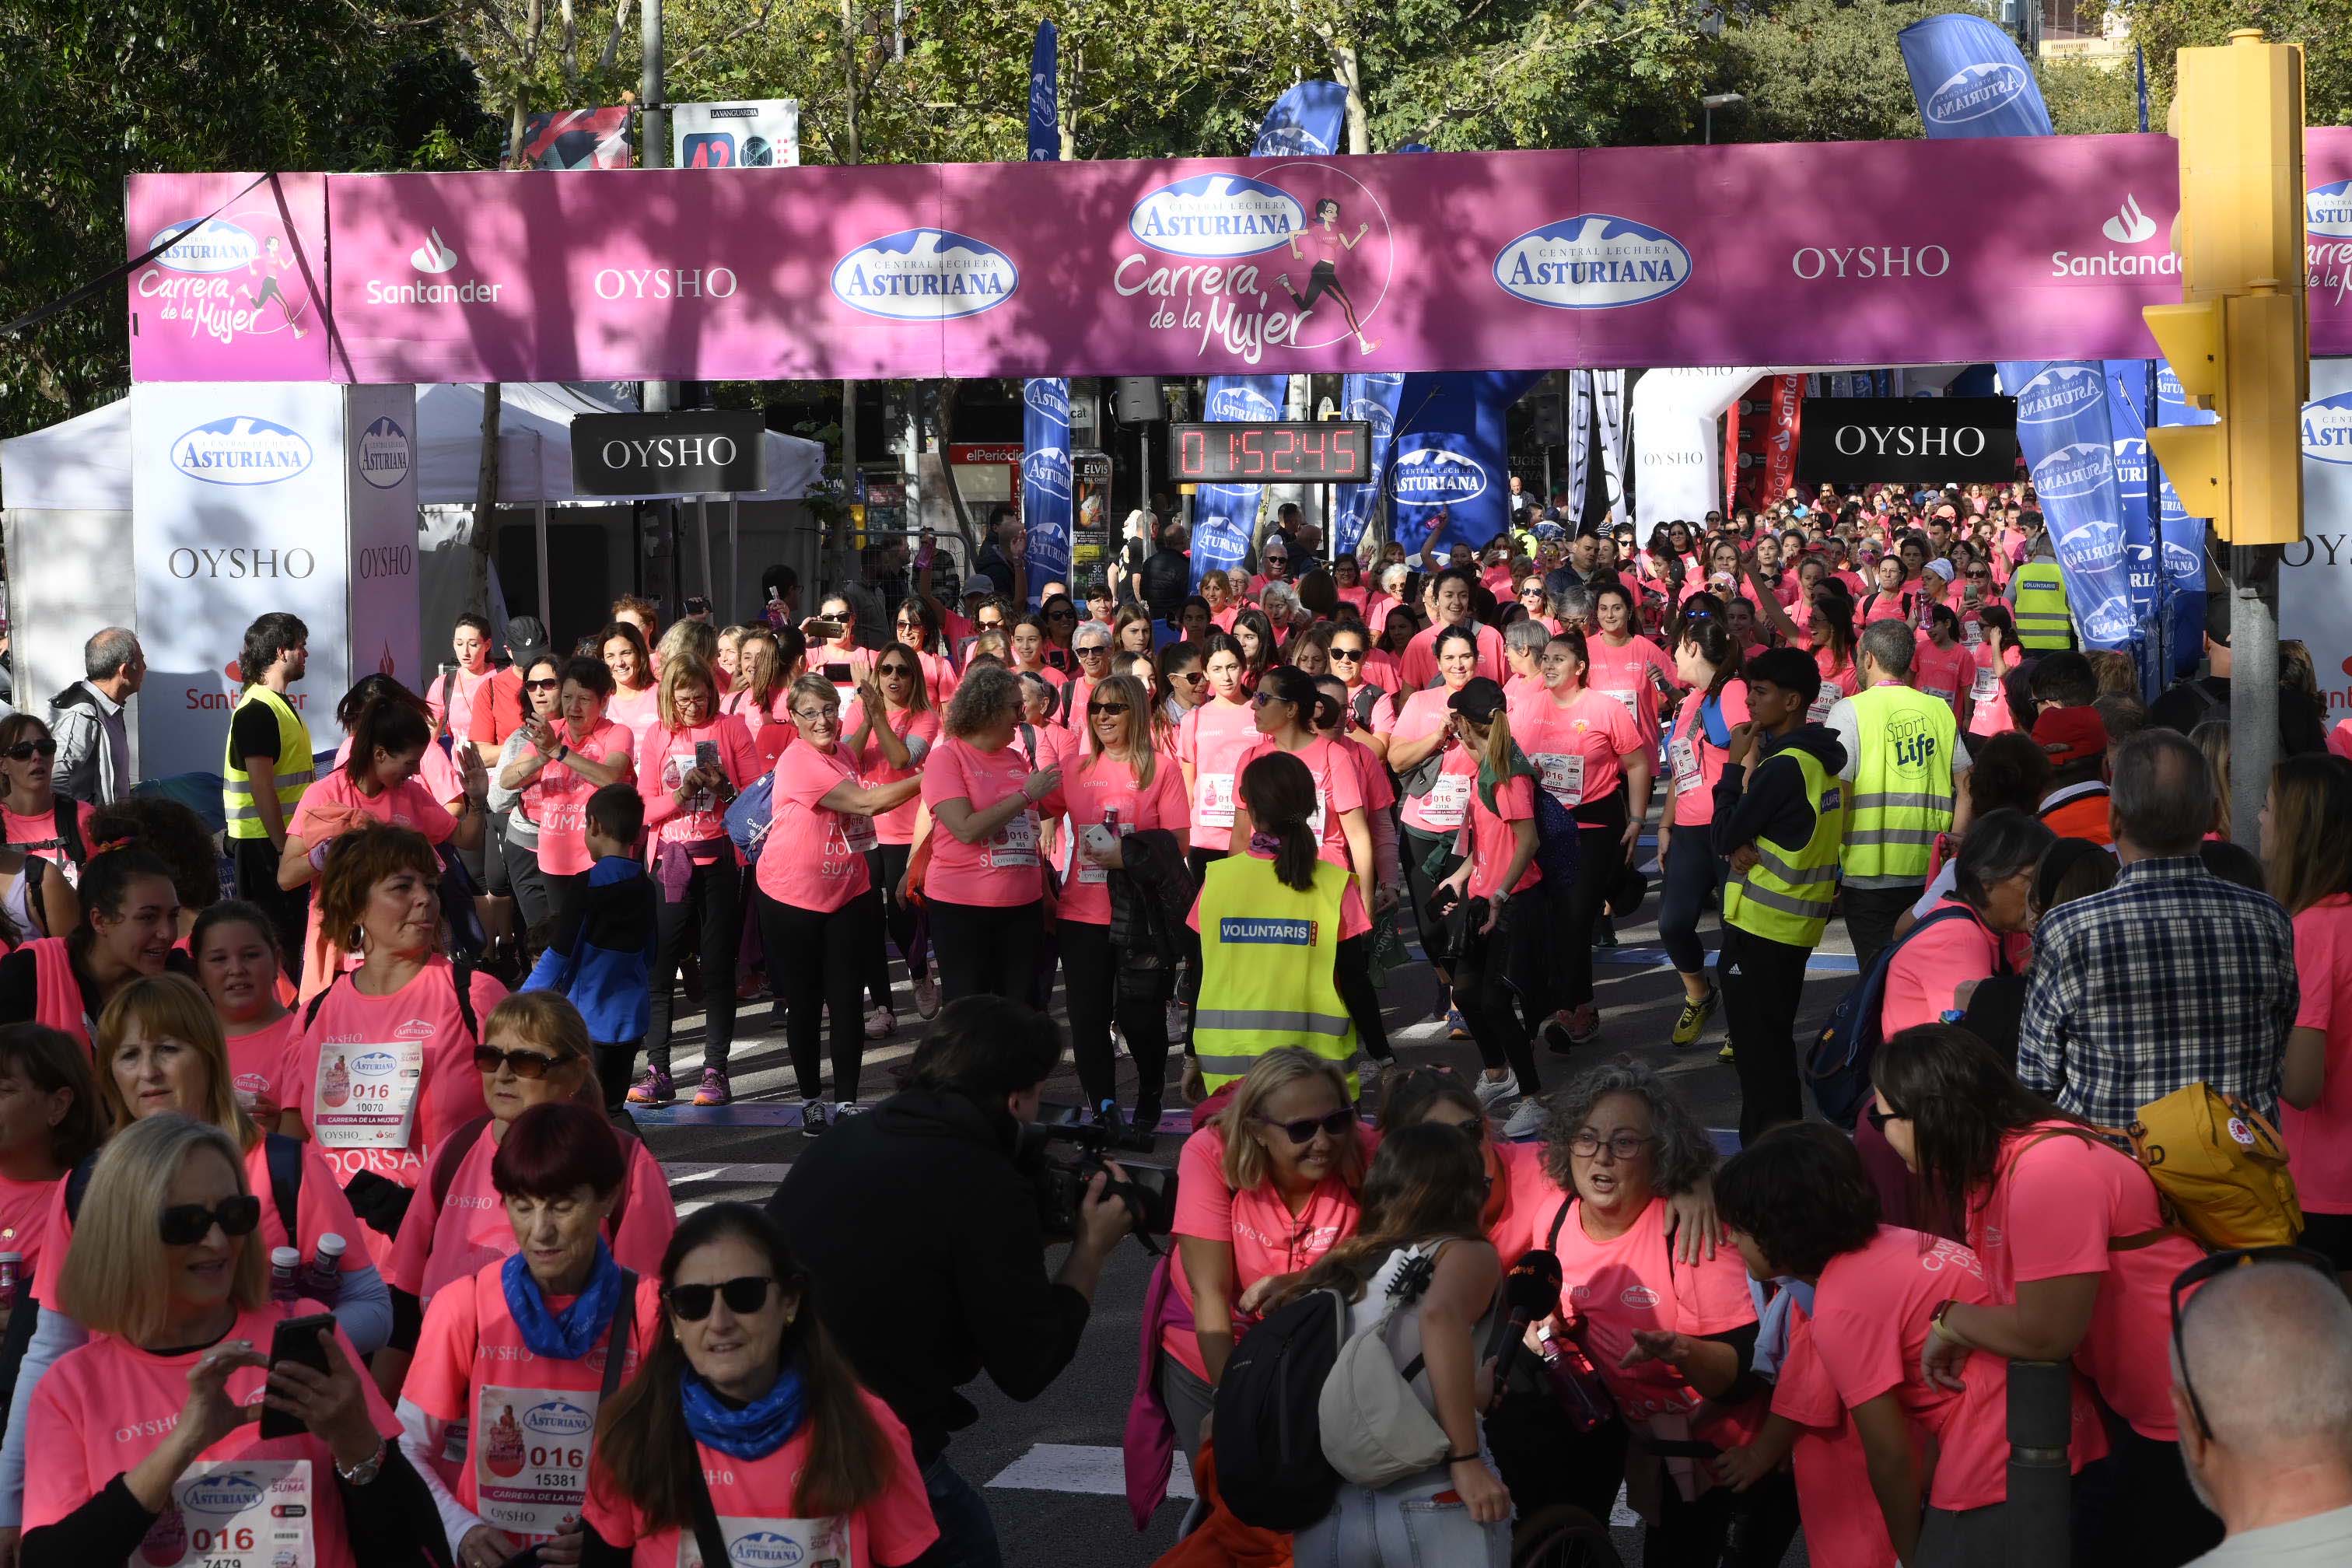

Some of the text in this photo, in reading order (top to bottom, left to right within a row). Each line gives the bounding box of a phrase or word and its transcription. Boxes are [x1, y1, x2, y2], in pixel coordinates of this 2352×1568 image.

[1230, 201, 1286, 210] LECHERA
[1142, 205, 1292, 237] ASTURIANA
[1539, 246, 1670, 257] CENTRAL LECHERA
[2307, 243, 2352, 265] arre
[874, 259, 997, 268] CENTRAL LECHERA
[1509, 250, 1676, 285] ASTURIANA
[1792, 244, 1950, 279] OYSHO
[2052, 250, 2182, 277] Santand
[138, 269, 229, 298] Carrera
[594, 268, 737, 299] OYSHO
[846, 263, 1004, 296] ASTURIANA
[1114, 254, 1259, 297] Carrera
[2324, 268, 2338, 287] la
[367, 279, 502, 305] Santander
[160, 301, 194, 320] de la
[1150, 297, 1202, 330] de la
[191, 297, 264, 344] Mujer
[1198, 292, 1313, 365] Mujer
[1030, 385, 1069, 419] ASTURIAN
[1835, 425, 1986, 457] OYSHO
[182, 442, 303, 468] ASTURIANA
[362, 446, 408, 471] ASTURIANA
[602, 436, 737, 469] OYSHO
[966, 449, 1024, 462] elPeriódic
[1181, 430, 1356, 474] 01:52:45
[1643, 451, 1703, 467] OYSHO
[1028, 459, 1070, 492] ASTURIAN
[1083, 464, 1108, 474] ELVIS
[1392, 472, 1479, 493] ASTURIANA
[168, 548, 315, 579] OYSHO
[359, 544, 411, 579] OYSHO
[1092, 565, 1102, 573] 30
[186, 688, 308, 710] Santer
[1819, 696, 1833, 705] 016
[1887, 716, 1927, 743] Sport
[1895, 733, 1935, 767] Life
[1545, 771, 1563, 781] 016
[553, 803, 586, 813] DORSA
[663, 826, 705, 840] SUMA
[1010, 831, 1029, 841] 016
[1222, 925, 1307, 939] VOLUNTARIS
[396, 1026, 434, 1037] ASTURIANA
[355, 1061, 394, 1070] ASTURIANA
[352, 1083, 389, 1098] 016
[356, 1103, 383, 1112] 10070
[324, 1131, 359, 1139] OYSHO
[325, 1144, 429, 1174] DORSA
[446, 1194, 492, 1210] OYSHO
[1562, 1282, 1591, 1299] YSHO
[1623, 1292, 1656, 1304] ASTURIANA
[528, 1413, 586, 1429] ASTURIANA
[530, 1446, 583, 1468] 016
[271, 1482, 306, 1493] SUMA
[534, 1473, 576, 1487] 15381
[190, 1487, 257, 1506] ASTURIANA
[492, 1490, 565, 1502] CARRERA DE LA
[491, 1507, 536, 1523] OYSHO
[192, 1528, 254, 1551] 016
[203, 1559, 241, 1568] 7479
[736, 1547, 798, 1561] ASTURIANA
